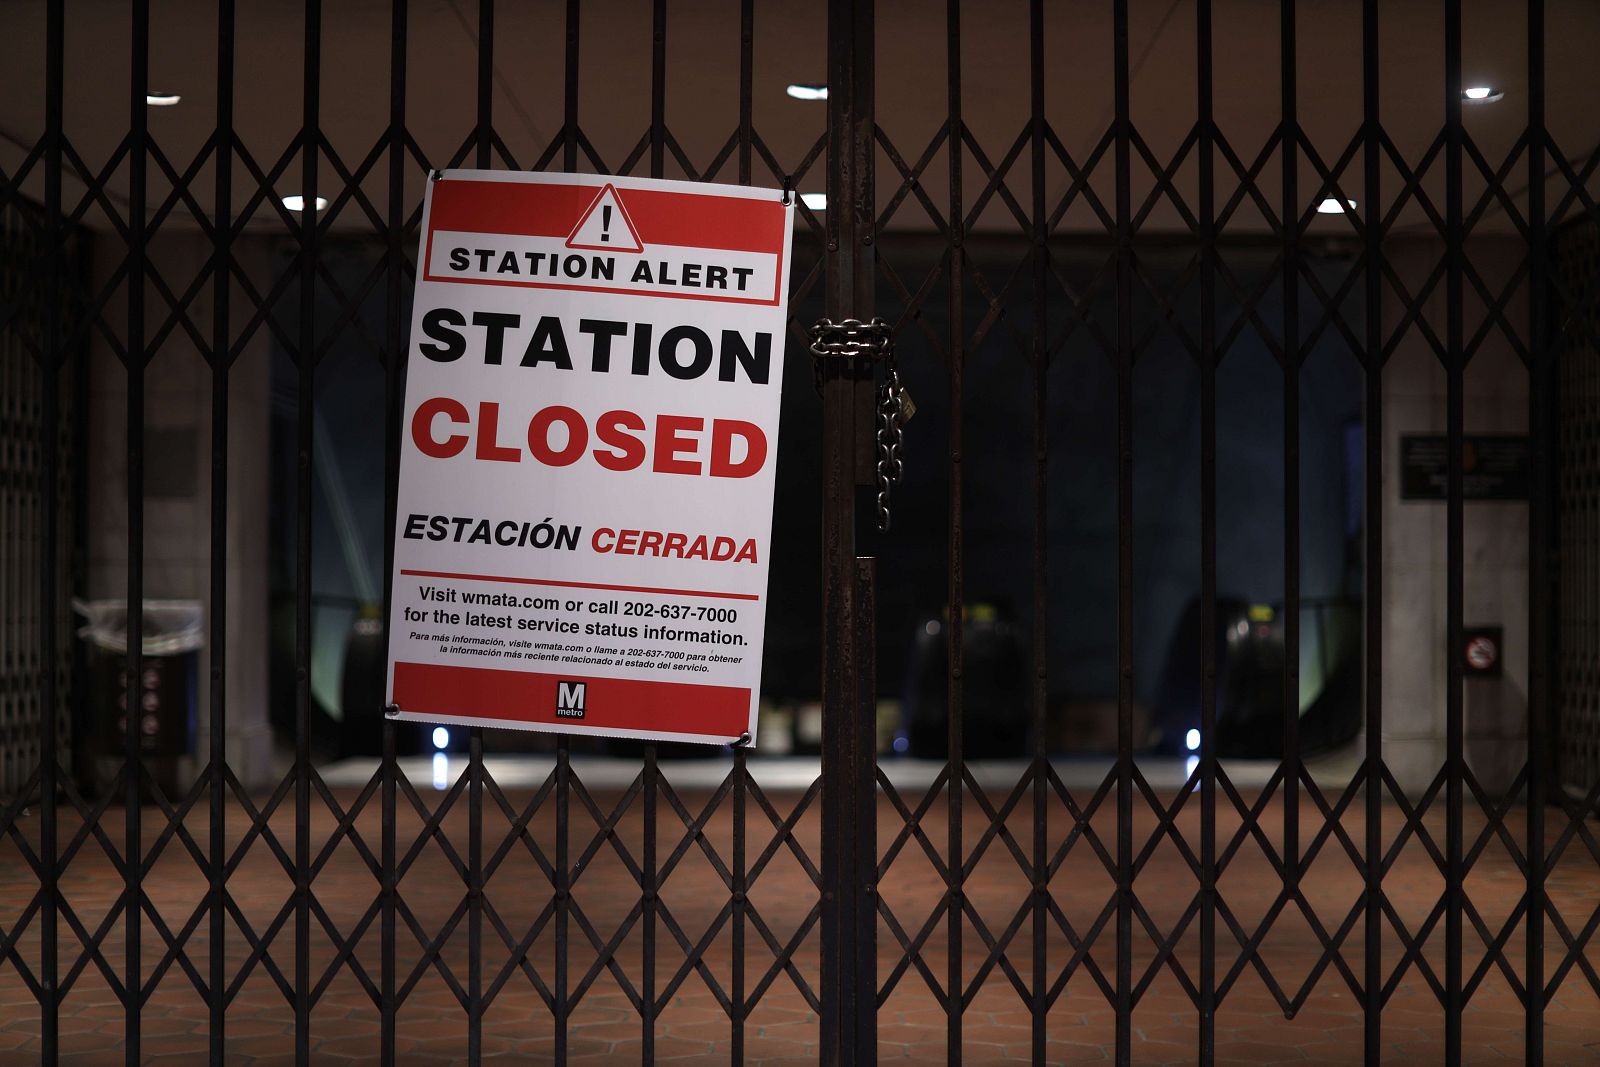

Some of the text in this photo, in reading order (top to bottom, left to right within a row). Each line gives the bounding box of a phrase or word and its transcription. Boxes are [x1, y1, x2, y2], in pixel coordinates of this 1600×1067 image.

[449, 247, 754, 291] STATION ALERT
[418, 307, 772, 385] STATION
[411, 396, 768, 479] CLOSED
[403, 513, 758, 564] ESTACIÓN CERRADA
[419, 586, 737, 624] Visit wmata.com or call 202-637-7000
[404, 606, 748, 646] for the latest service status information.
[409, 631, 430, 641] Para
[431, 633, 450, 643] más
[452, 634, 506, 648] información,
[509, 639, 532, 649] visite
[534, 642, 584, 653] wmata.com
[594, 645, 618, 655] llame
[627, 648, 685, 660] 202-637-7000
[686, 654, 706, 662] para
[708, 654, 743, 664] obtener
[439, 644, 709, 673] la información más reciente relacionado al estado del servicio.
[558, 709, 583, 717] metro
[559, 683, 585, 709] M
